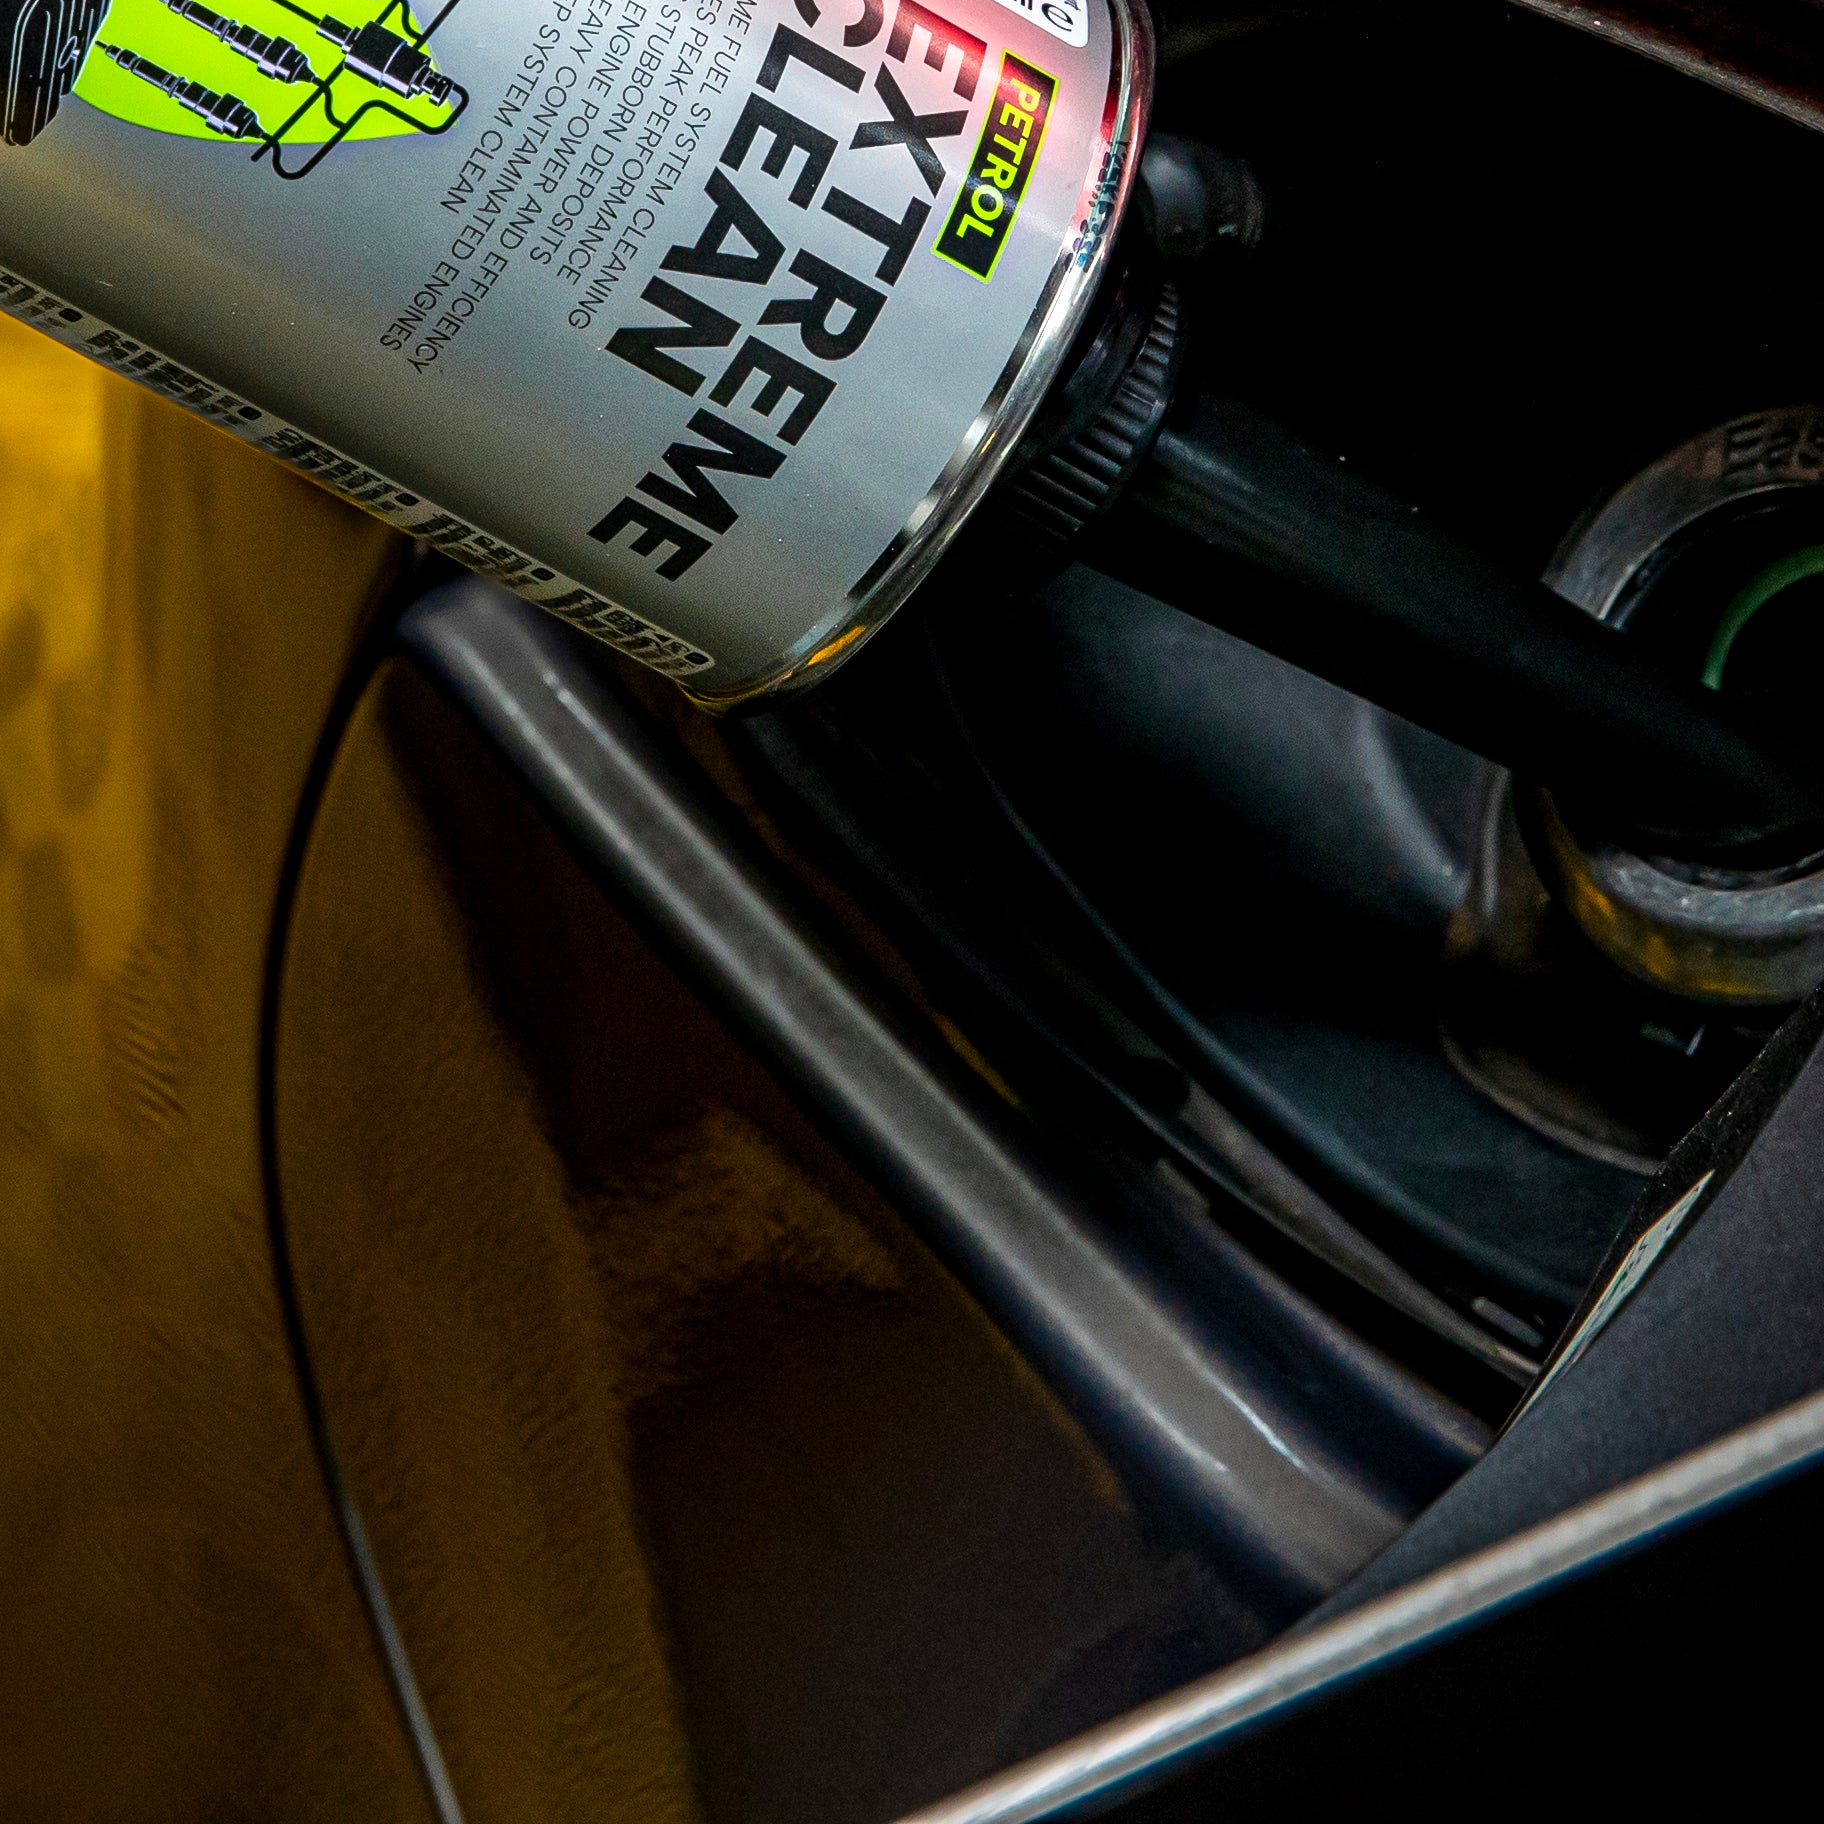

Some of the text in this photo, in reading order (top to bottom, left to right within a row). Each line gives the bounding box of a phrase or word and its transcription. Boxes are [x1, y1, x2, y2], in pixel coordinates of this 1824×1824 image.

[494, 25, 560, 127] SYSTEM
[588, 0, 646, 98] ENGINE
[603, 5, 680, 142] STUBBORN
[665, 27, 708, 96] PEAK
[699, 35, 741, 94] FUEL
[440, 131, 503, 214] CLEAN
[452, 67, 576, 260] CONTAMINATED
[533, 99, 599, 193] POWER
[556, 96, 677, 285] PERFORMANCE
[646, 103, 711, 205] SYSTEM
[956, 77, 1042, 238] PETROL
[500, 194, 542, 249] AND
[530, 144, 614, 264] DEPOSITS
[380, 262, 460, 350] ENGINES
[407, 252, 508, 374] EFFICIENCY
[569, 209, 654, 329] CLEANING
